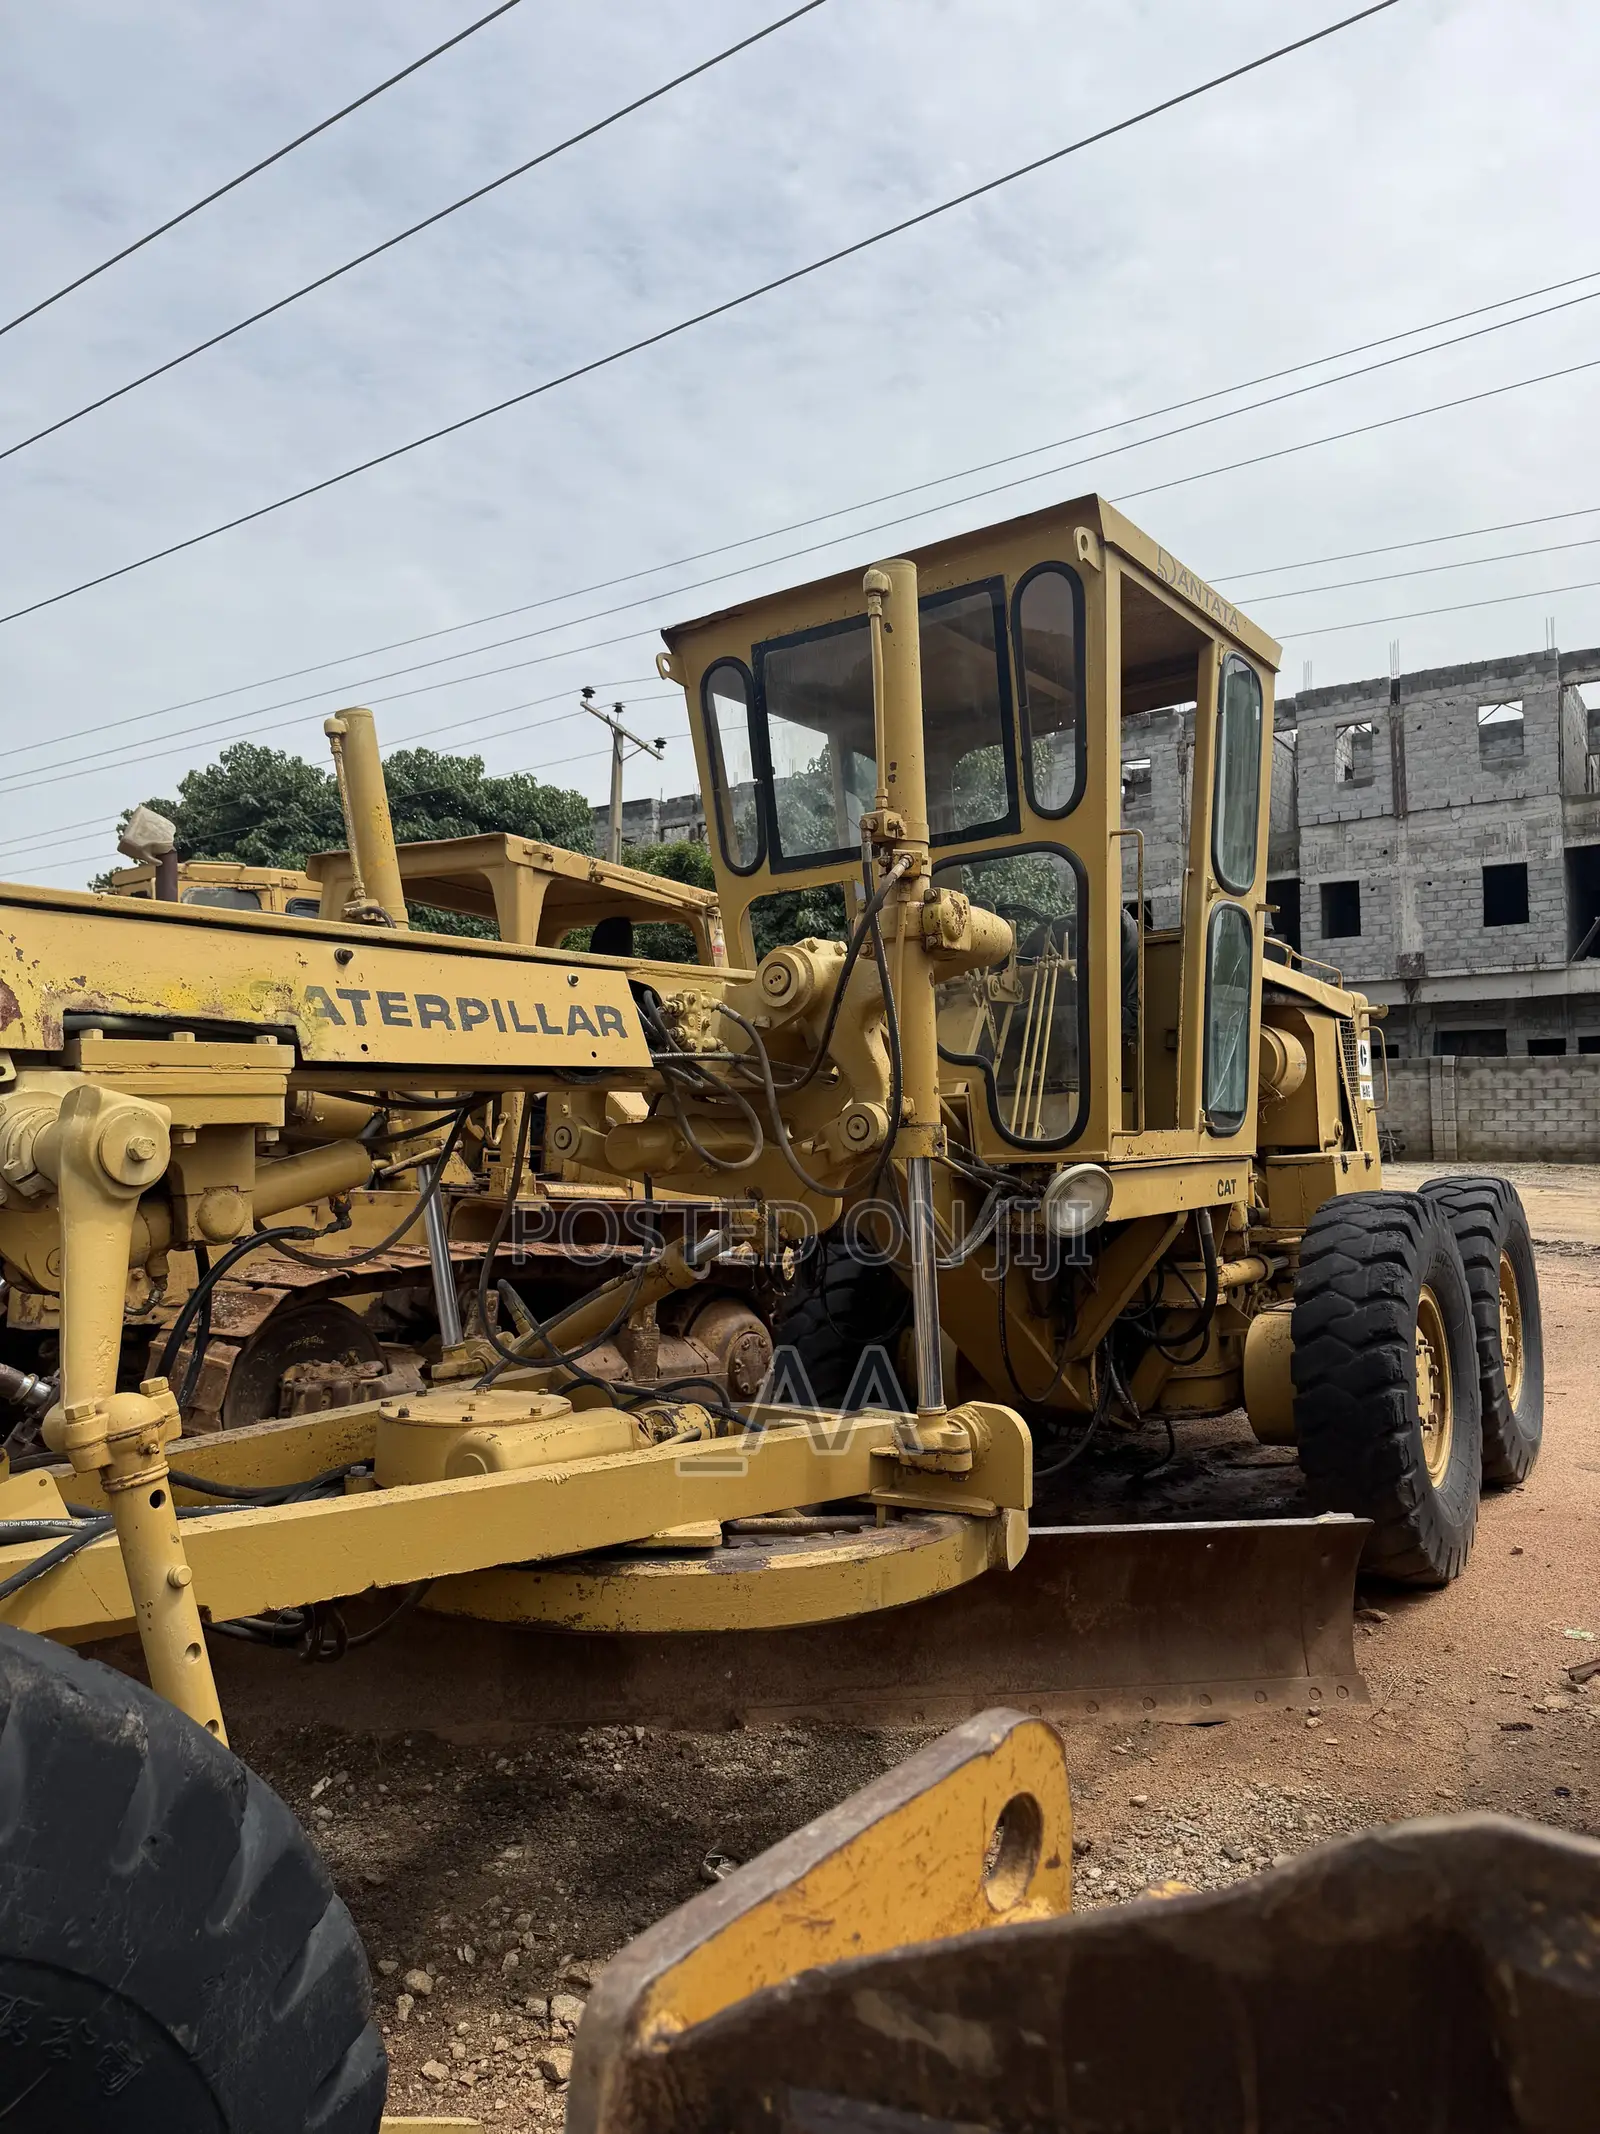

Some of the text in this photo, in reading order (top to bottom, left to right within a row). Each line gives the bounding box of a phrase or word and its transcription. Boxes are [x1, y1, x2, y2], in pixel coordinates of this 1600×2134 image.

[1157, 544, 1239, 632] DANTATA
[249, 980, 629, 1039] ATERPILLAR
[1217, 1179, 1237, 1197] CAT
